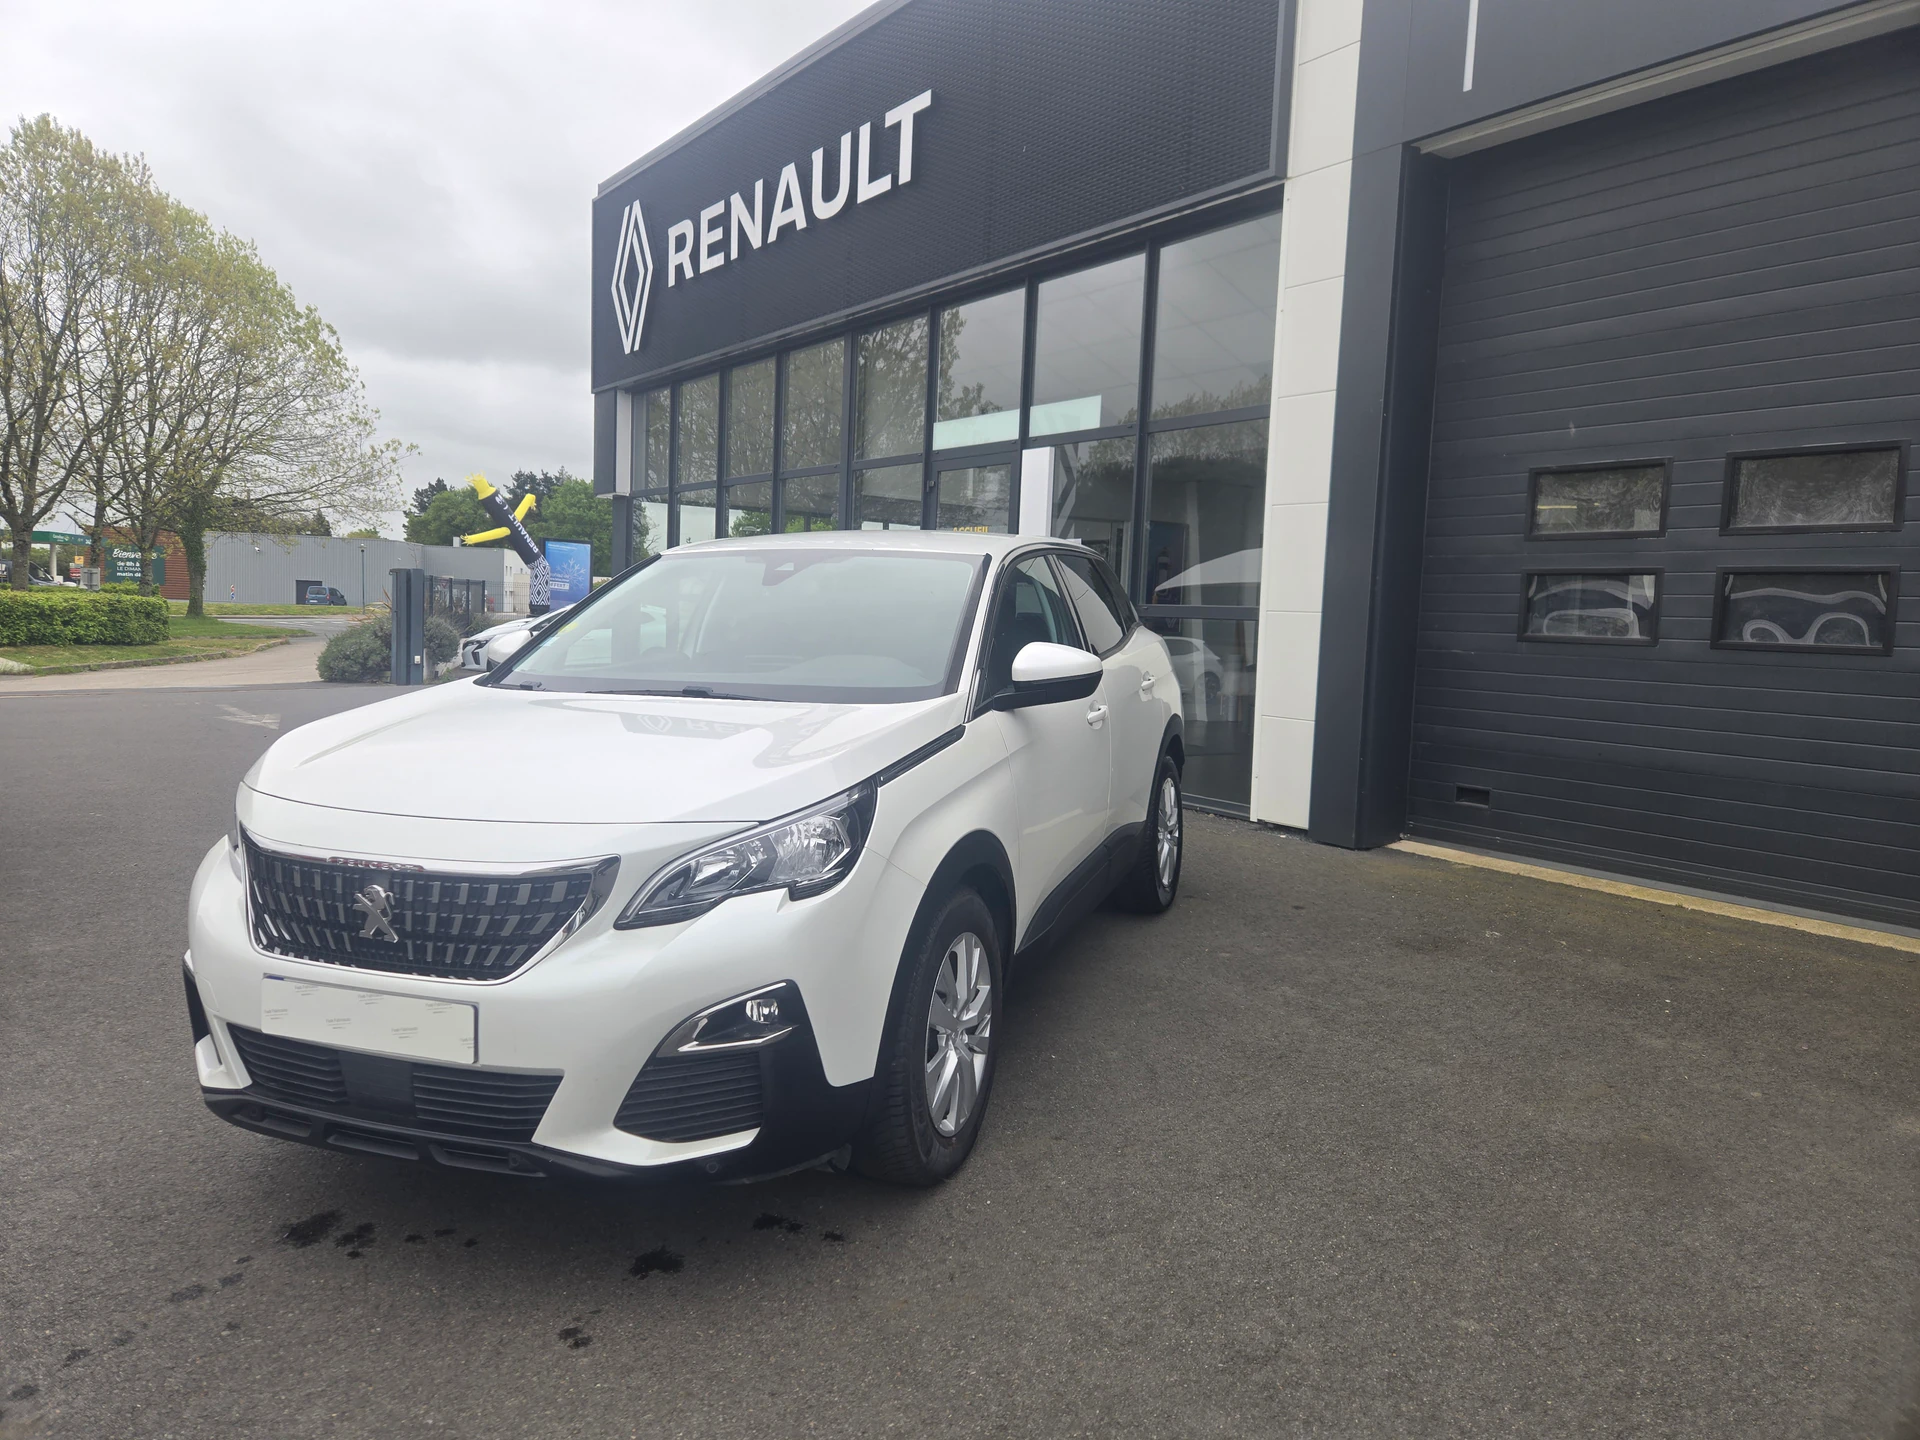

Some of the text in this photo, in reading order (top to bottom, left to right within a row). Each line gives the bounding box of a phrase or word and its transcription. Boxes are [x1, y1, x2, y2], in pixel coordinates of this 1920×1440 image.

[667, 89, 932, 288] RENAULT
[508, 513, 539, 554] RENAULT
[336, 858, 414, 872] PEUGEOT
